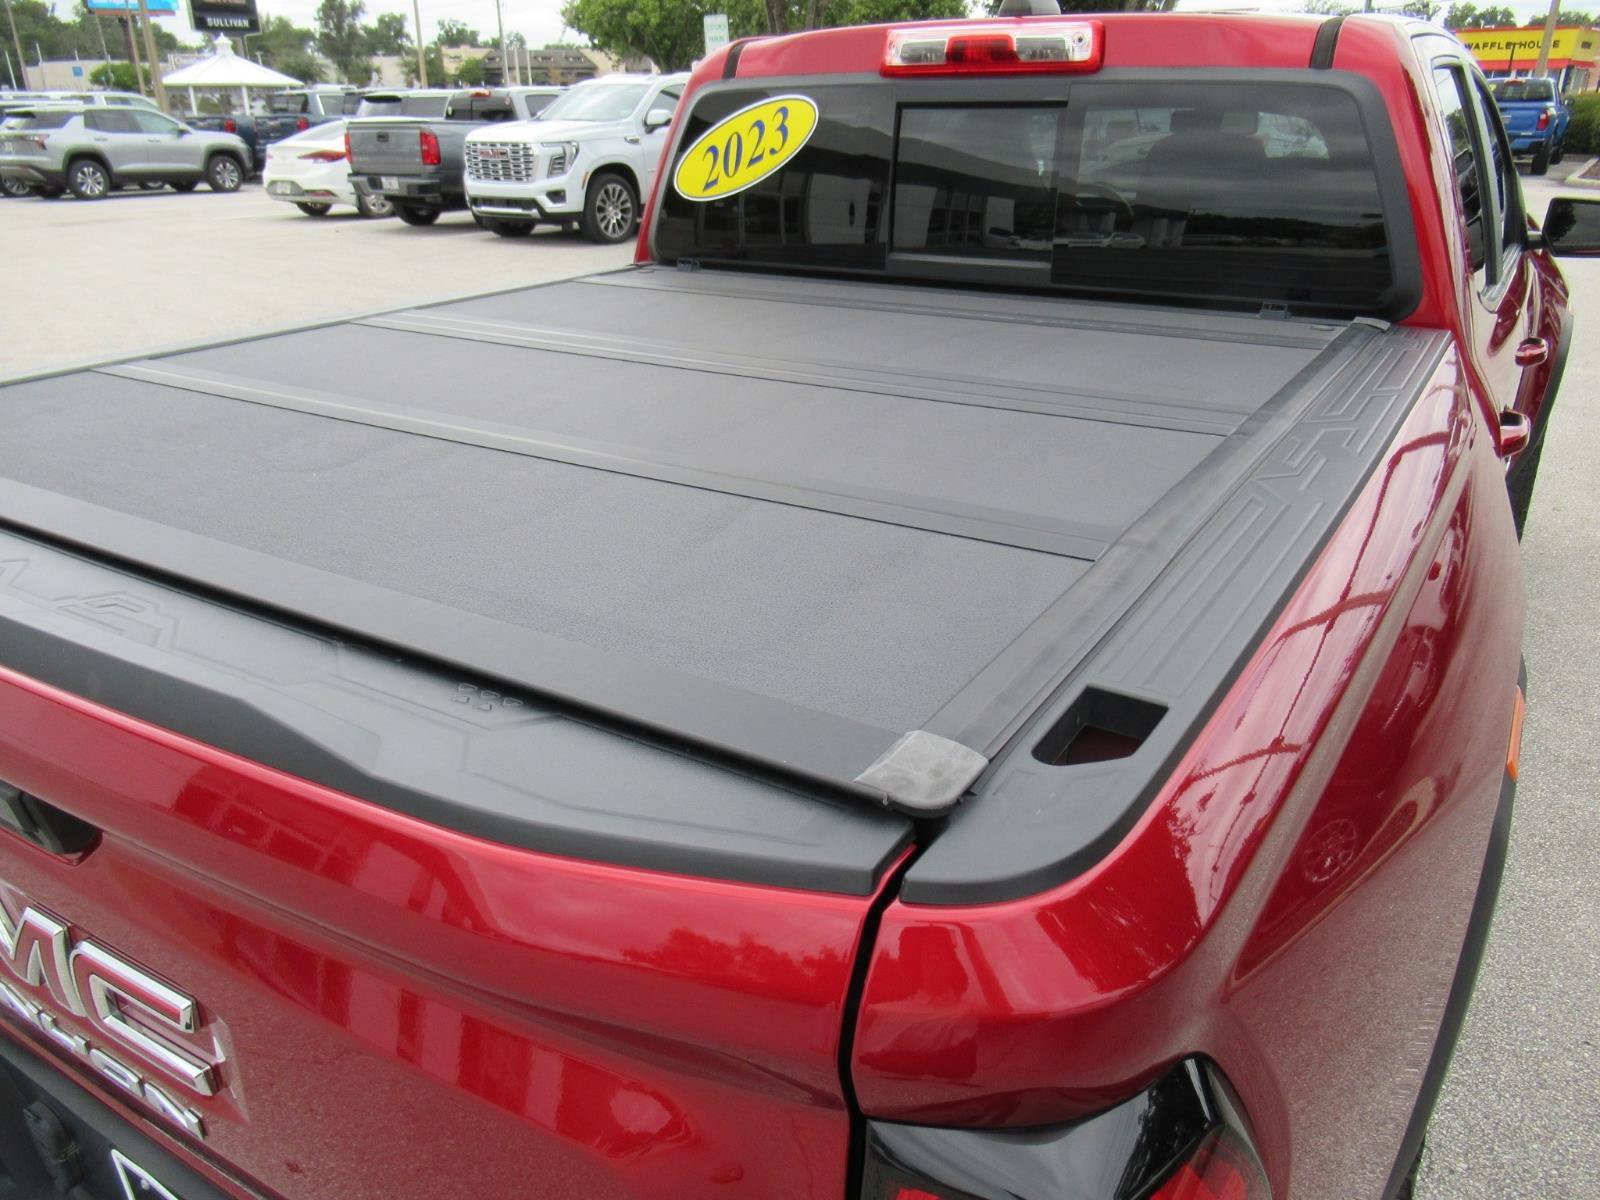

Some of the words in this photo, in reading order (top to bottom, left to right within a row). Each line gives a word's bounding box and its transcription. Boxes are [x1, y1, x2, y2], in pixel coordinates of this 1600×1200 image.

[207, 17, 250, 28] SULLIVAN
[1464, 41, 1513, 50] WAFFLE
[1518, 39, 1561, 49] HOUE
[702, 106, 789, 192] 2023
